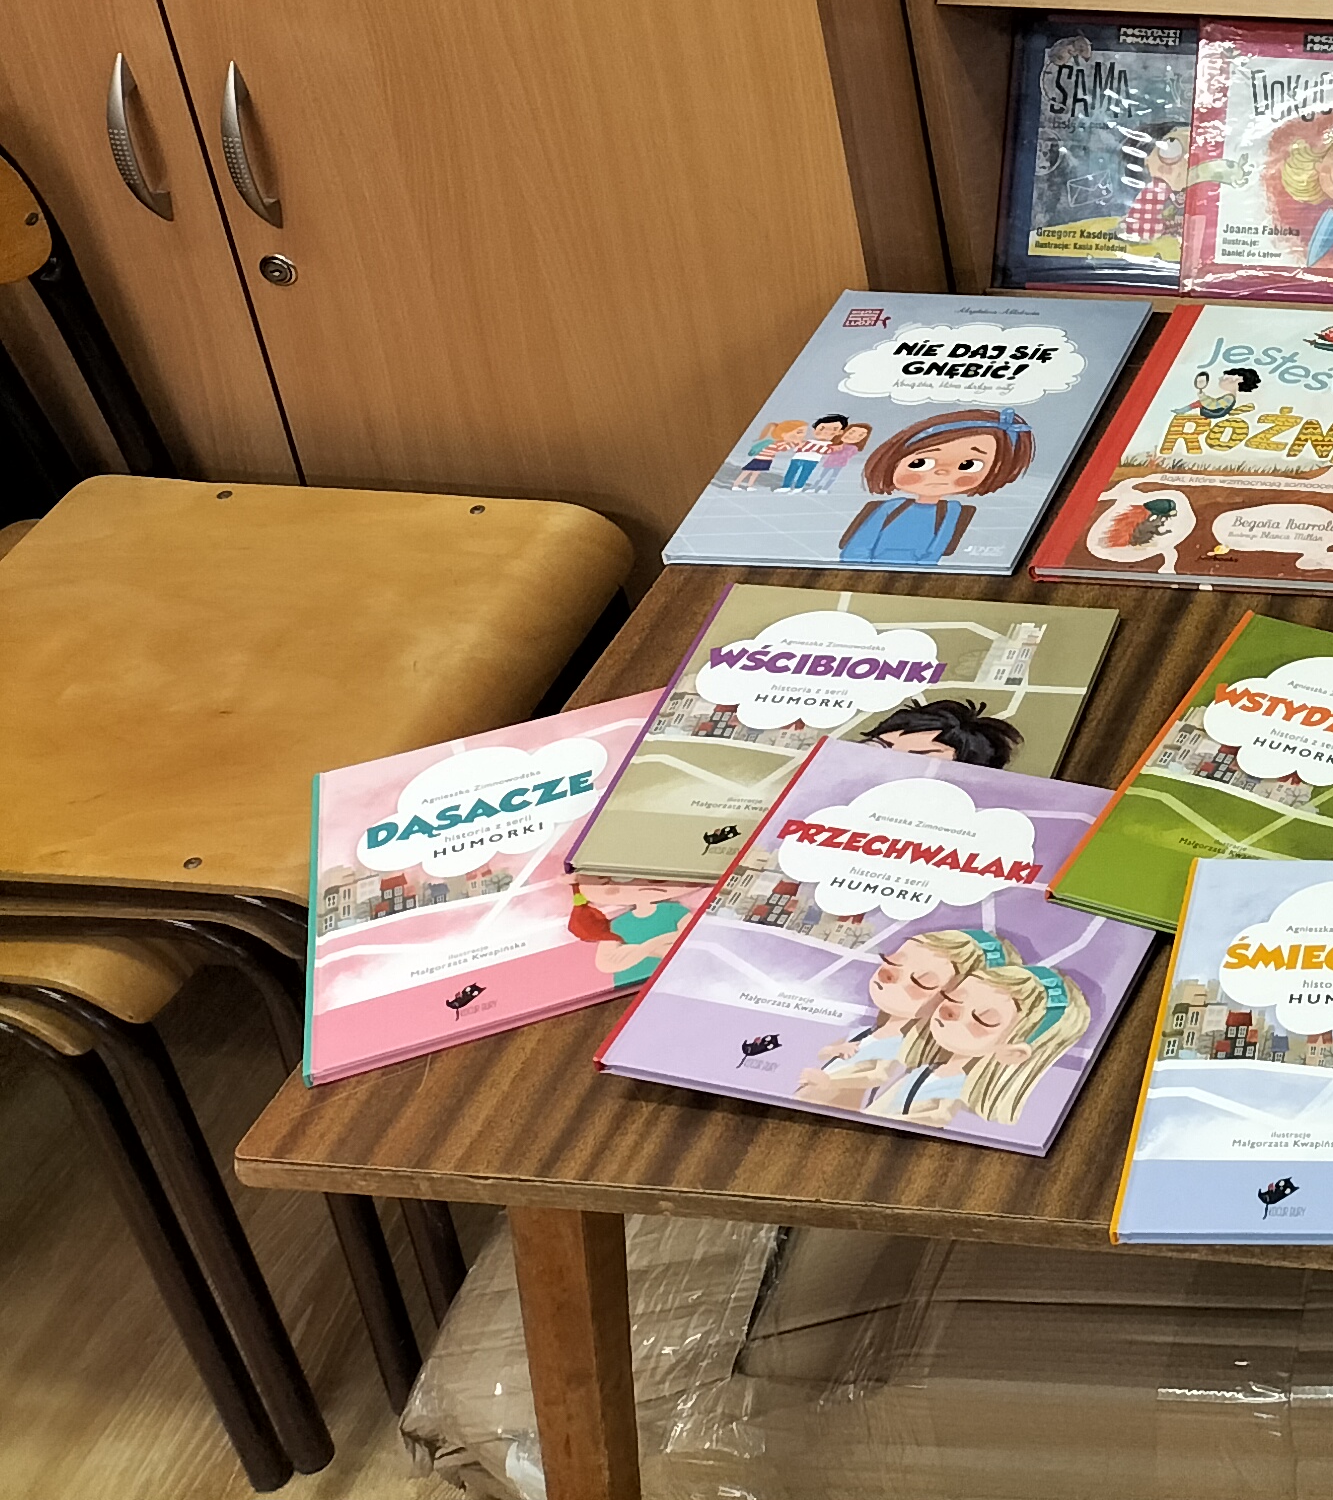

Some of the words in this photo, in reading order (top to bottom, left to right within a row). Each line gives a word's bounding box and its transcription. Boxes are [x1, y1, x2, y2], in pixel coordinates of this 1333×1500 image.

[947, 343, 1009, 360] DAJ
[902, 357, 1032, 381] GNĘBIĆ!
[709, 641, 948, 687] WŚCIBIONKI
[754, 692, 854, 710] HUMORKI
[365, 770, 595, 850] DĄSACZE
[432, 821, 546, 860] HUMORKI
[776, 818, 1043, 886] PRZECHWALAKI
[829, 875, 933, 905] HUMORKI
[1286, 924, 1333, 937] Agnieszka
[739, 991, 791, 1011] Małgorzata
[1232, 1137, 1289, 1150] Małgorzata
